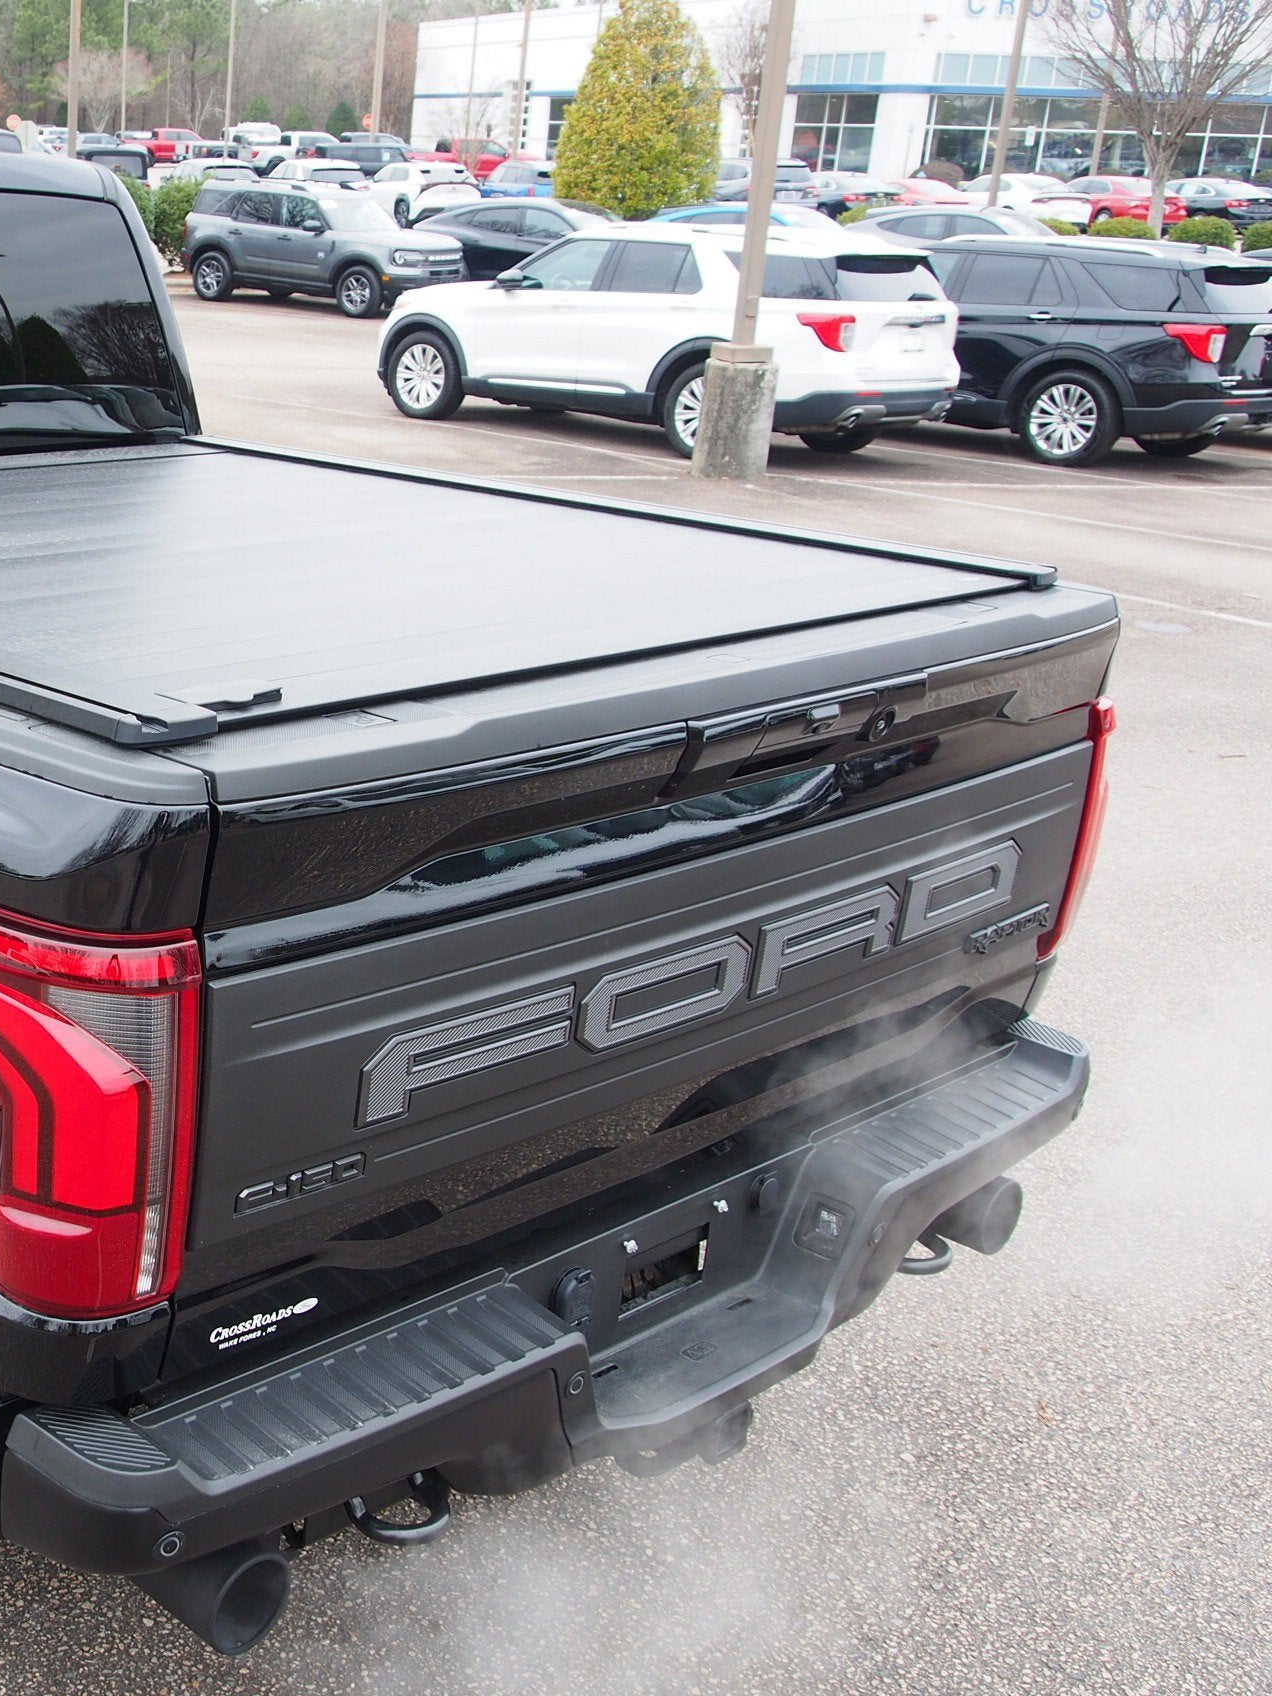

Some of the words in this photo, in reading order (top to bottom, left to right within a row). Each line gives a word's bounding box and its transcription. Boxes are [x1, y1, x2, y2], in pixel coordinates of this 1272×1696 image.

[964, 902, 1050, 954] RAPTOR
[354, 838, 1024, 1129] FORD
[234, 1152, 366, 1218] F-150
[218, 1337, 239, 1350] WAKE
[266, 1325, 277, 1334] NC
